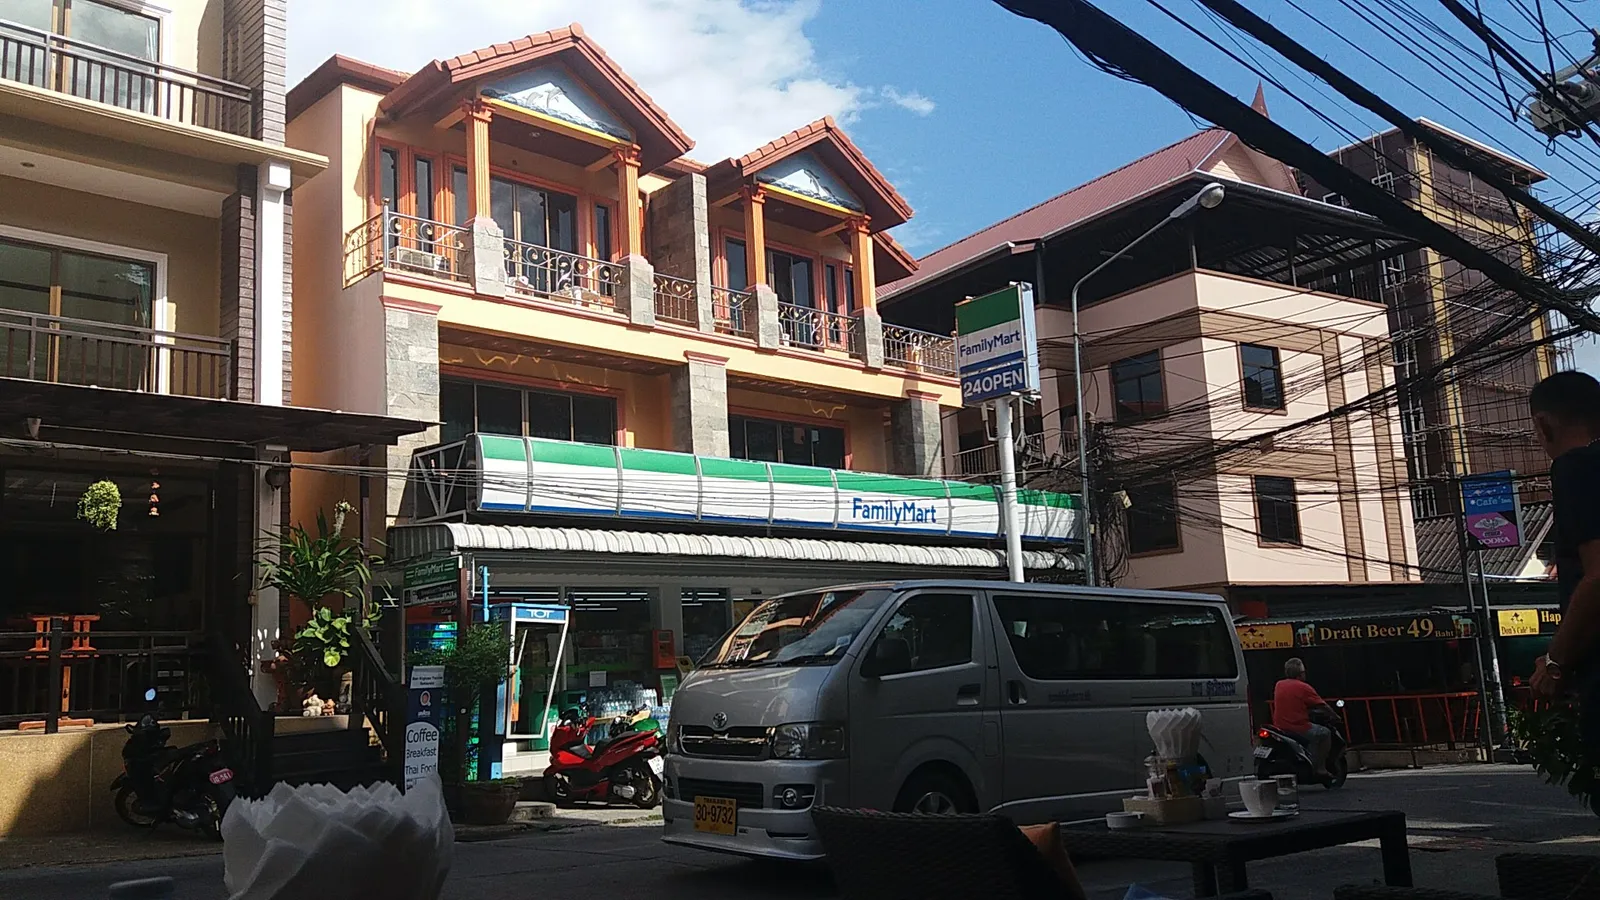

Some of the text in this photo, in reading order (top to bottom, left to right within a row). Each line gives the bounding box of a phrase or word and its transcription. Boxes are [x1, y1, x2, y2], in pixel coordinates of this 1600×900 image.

[960, 330, 1021, 357] FamilyMart
[963, 368, 1023, 397] 24OPEN
[852, 497, 937, 526] FamilyMart
[1478, 537, 1510, 545] VODKA
[415, 563, 444, 576] FamilyMart
[526, 609, 555, 619] TOT
[1541, 611, 1561, 625] Hap
[1319, 625, 1362, 641] Draft
[1366, 623, 1405, 638] Beer
[1407, 618, 1434, 638] 49
[407, 727, 438, 743] Coffee
[406, 747, 437, 759] Breakfast
[405, 764, 419, 775] Thai
[695, 803, 734, 825] 30-9732
